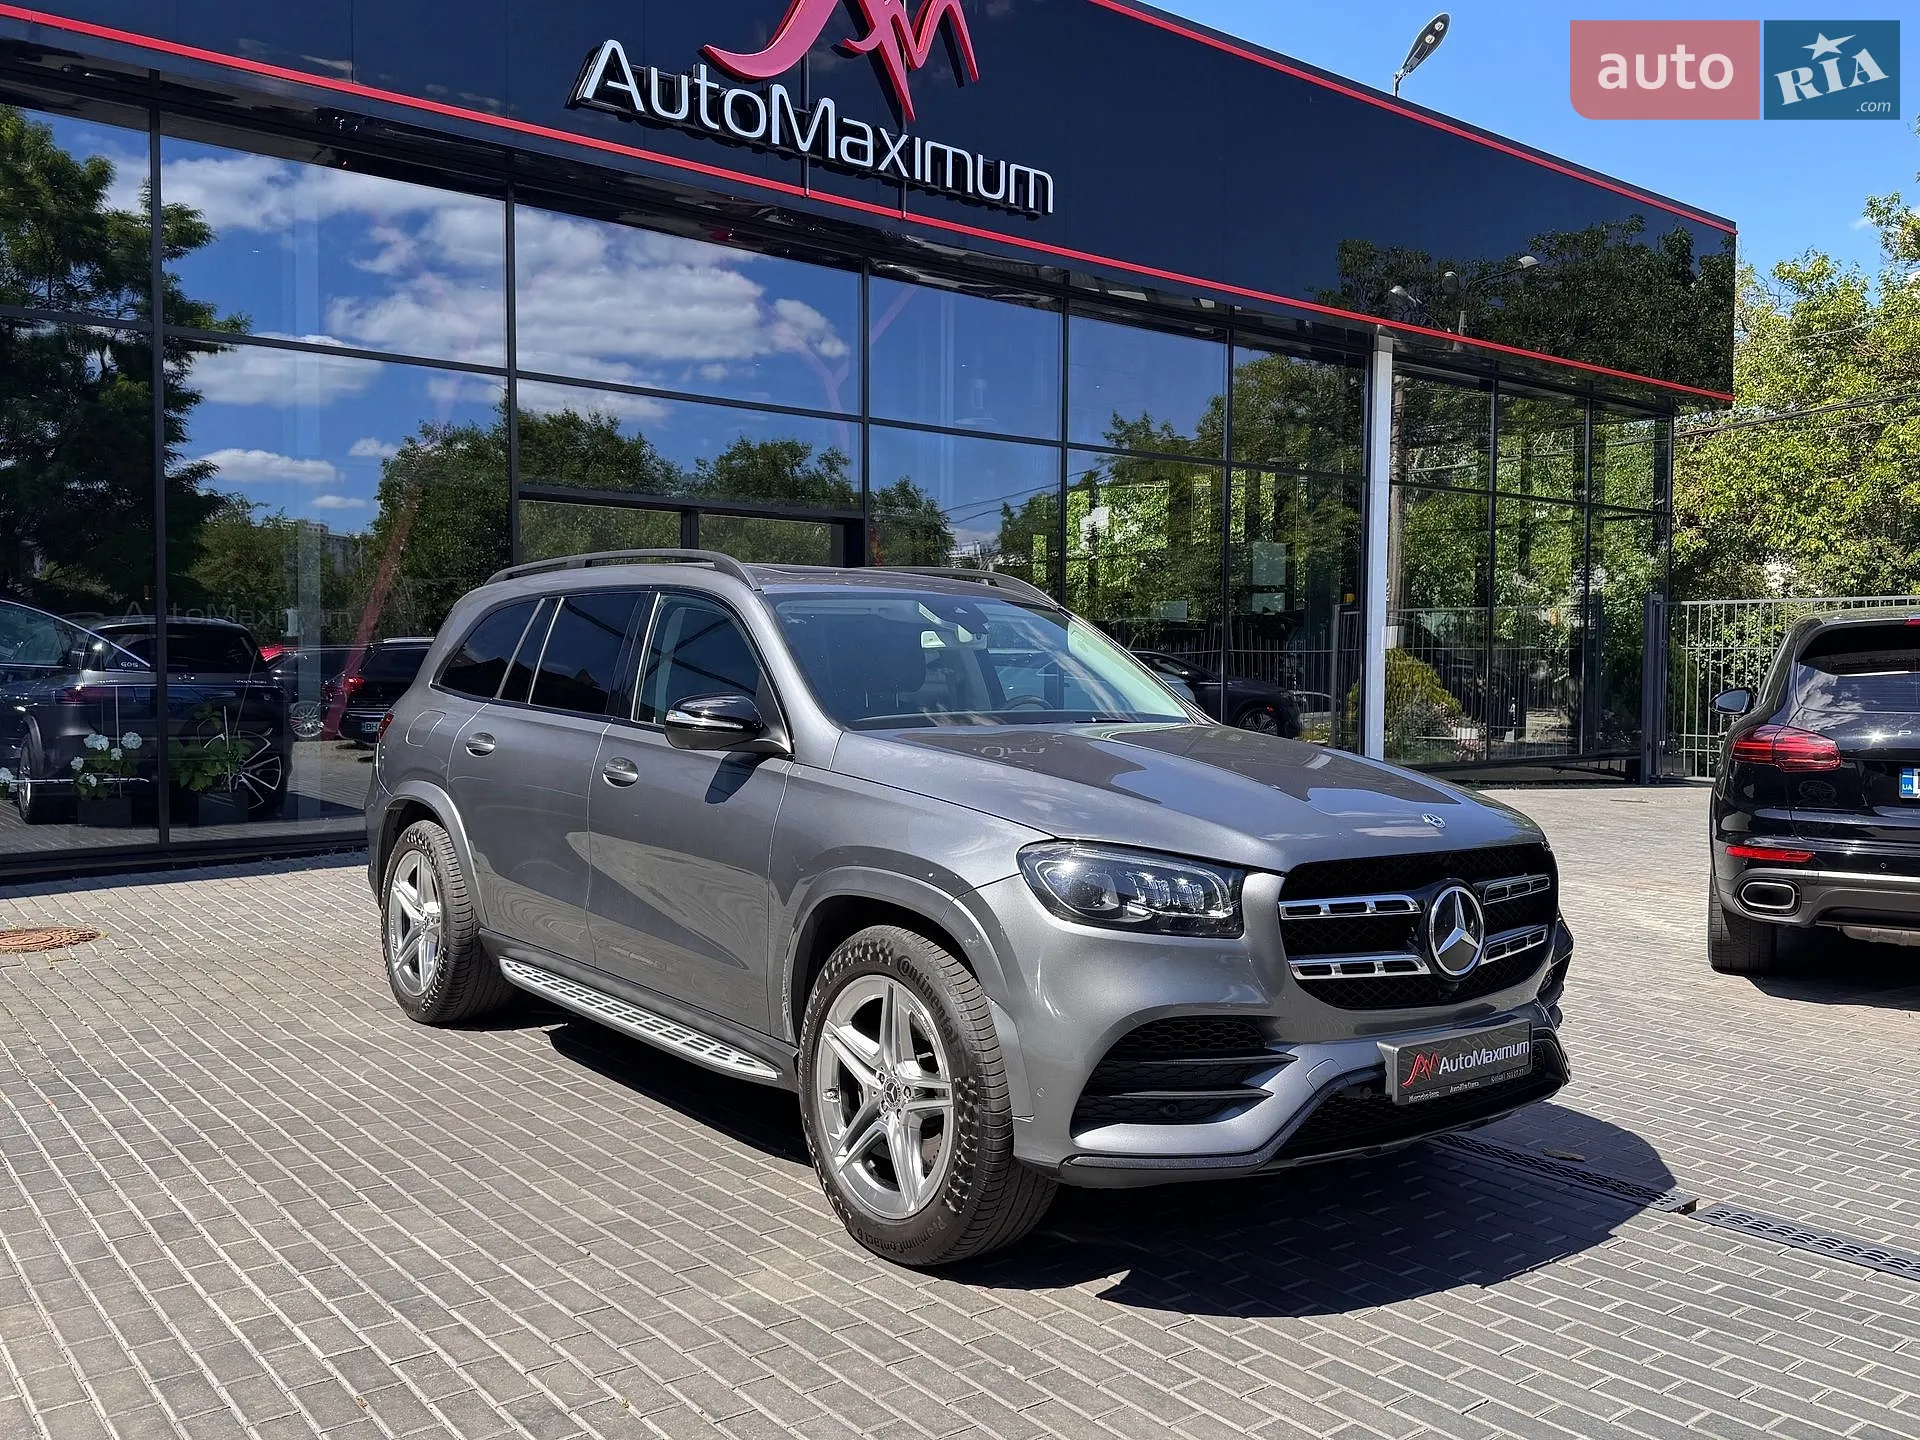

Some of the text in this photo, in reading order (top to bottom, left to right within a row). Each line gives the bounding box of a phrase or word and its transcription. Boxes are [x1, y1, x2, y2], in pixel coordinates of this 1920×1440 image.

[579, 39, 1055, 215] AutoMaximum
[897, 955, 959, 1045] Continental
[1438, 1041, 1530, 1075] AutoMaximum
